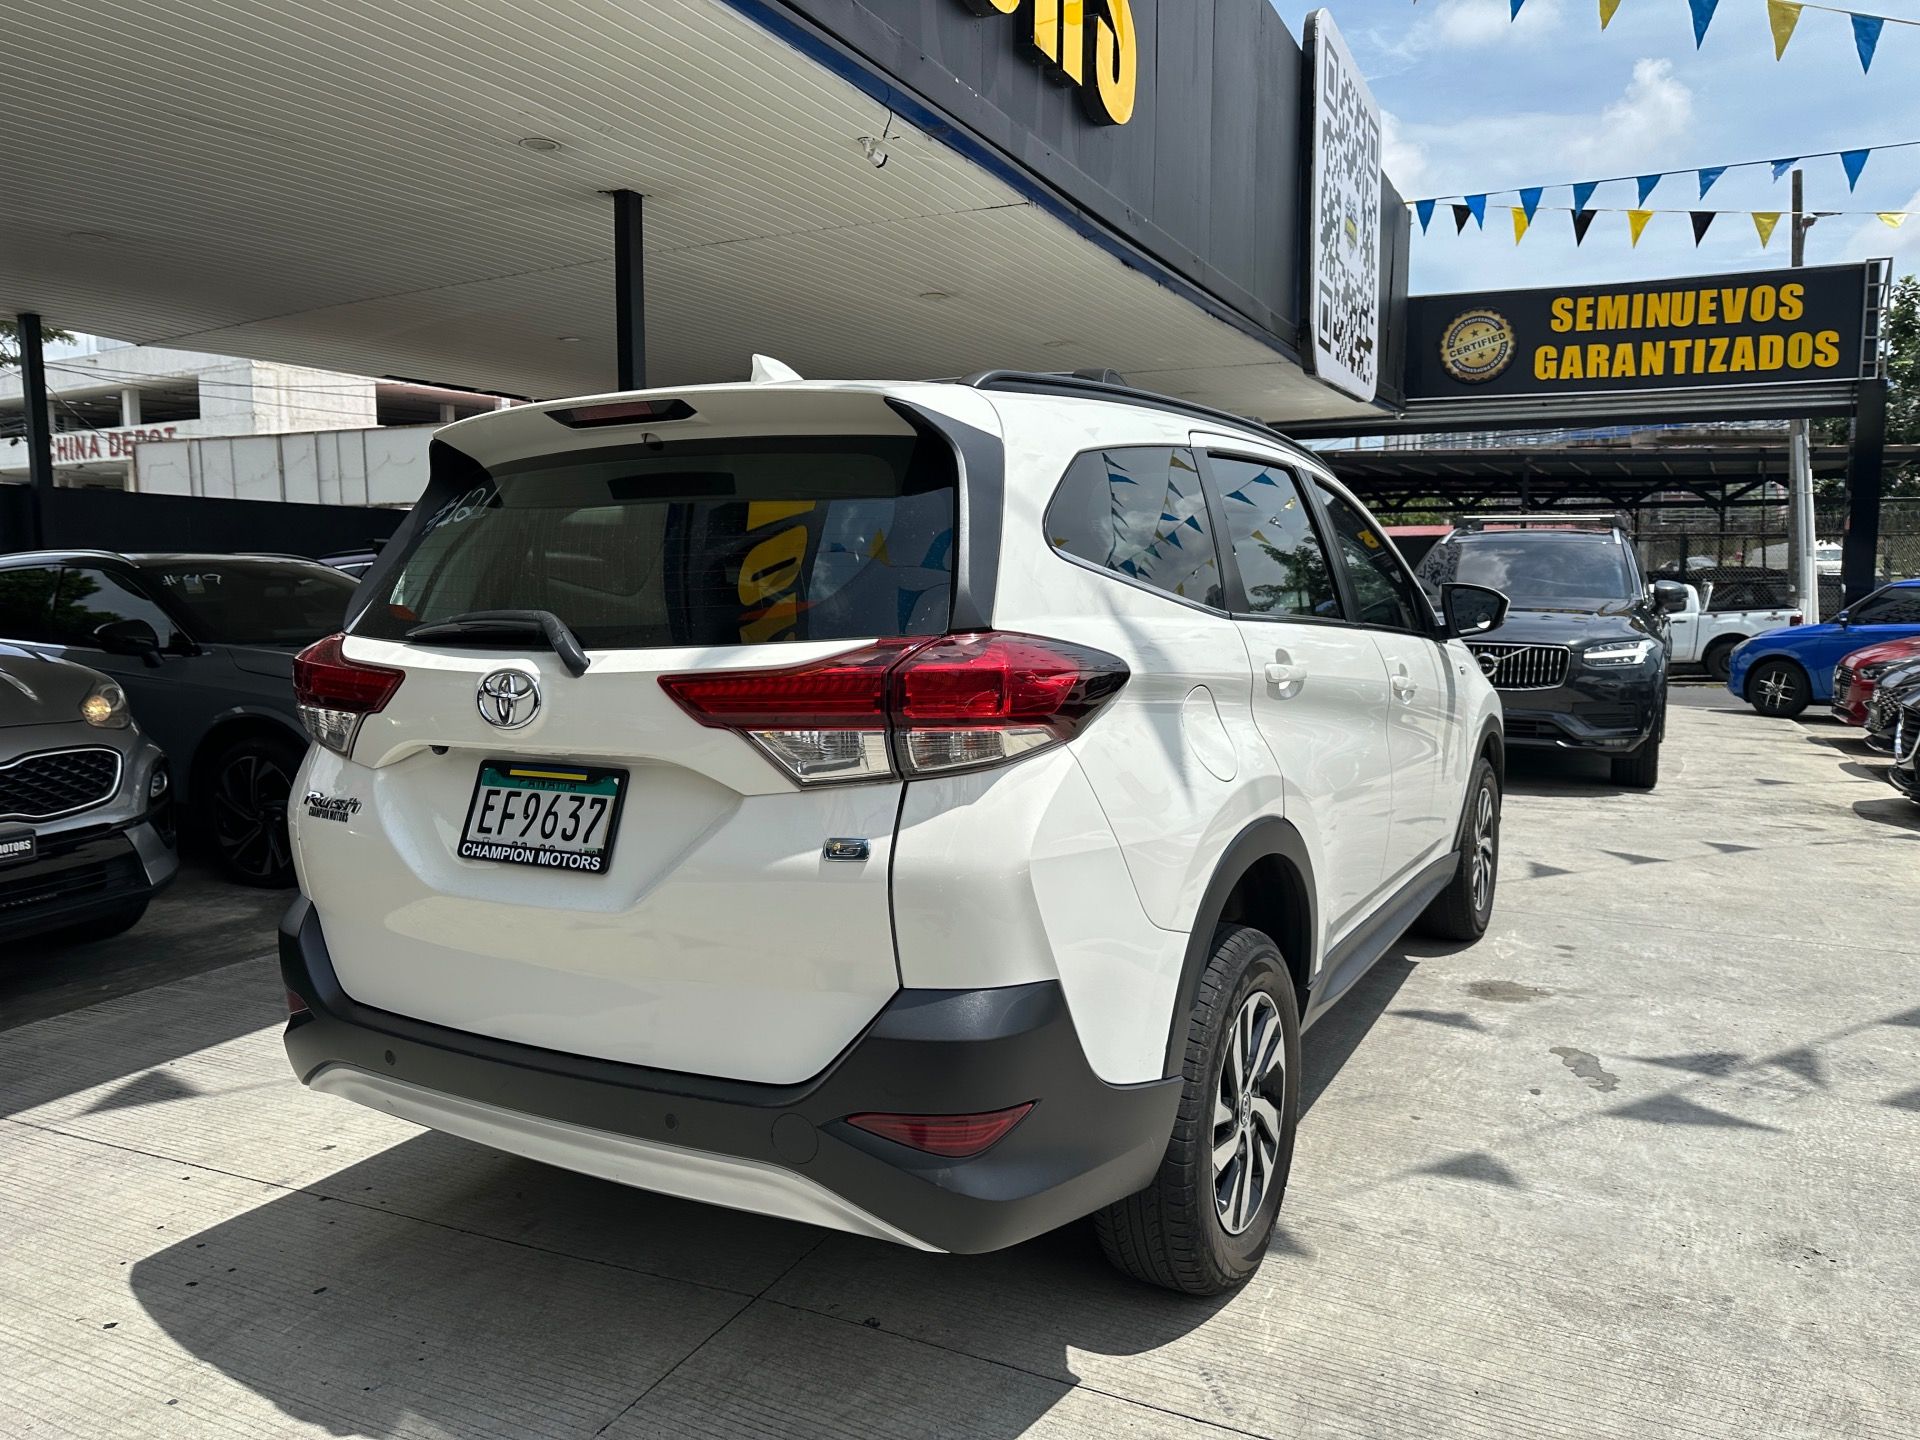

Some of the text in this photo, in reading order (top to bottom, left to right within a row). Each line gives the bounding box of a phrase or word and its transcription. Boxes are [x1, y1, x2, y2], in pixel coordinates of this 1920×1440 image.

[1550, 283, 1805, 333] SEMINUEVOS
[1449, 332, 1506, 358] CERTIFIED
[1534, 330, 1840, 381] GARANTIZADOS
[477, 789, 608, 844] EF9637
[462, 842, 534, 863] CHAMPION
[537, 850, 601, 871] MOTORS
